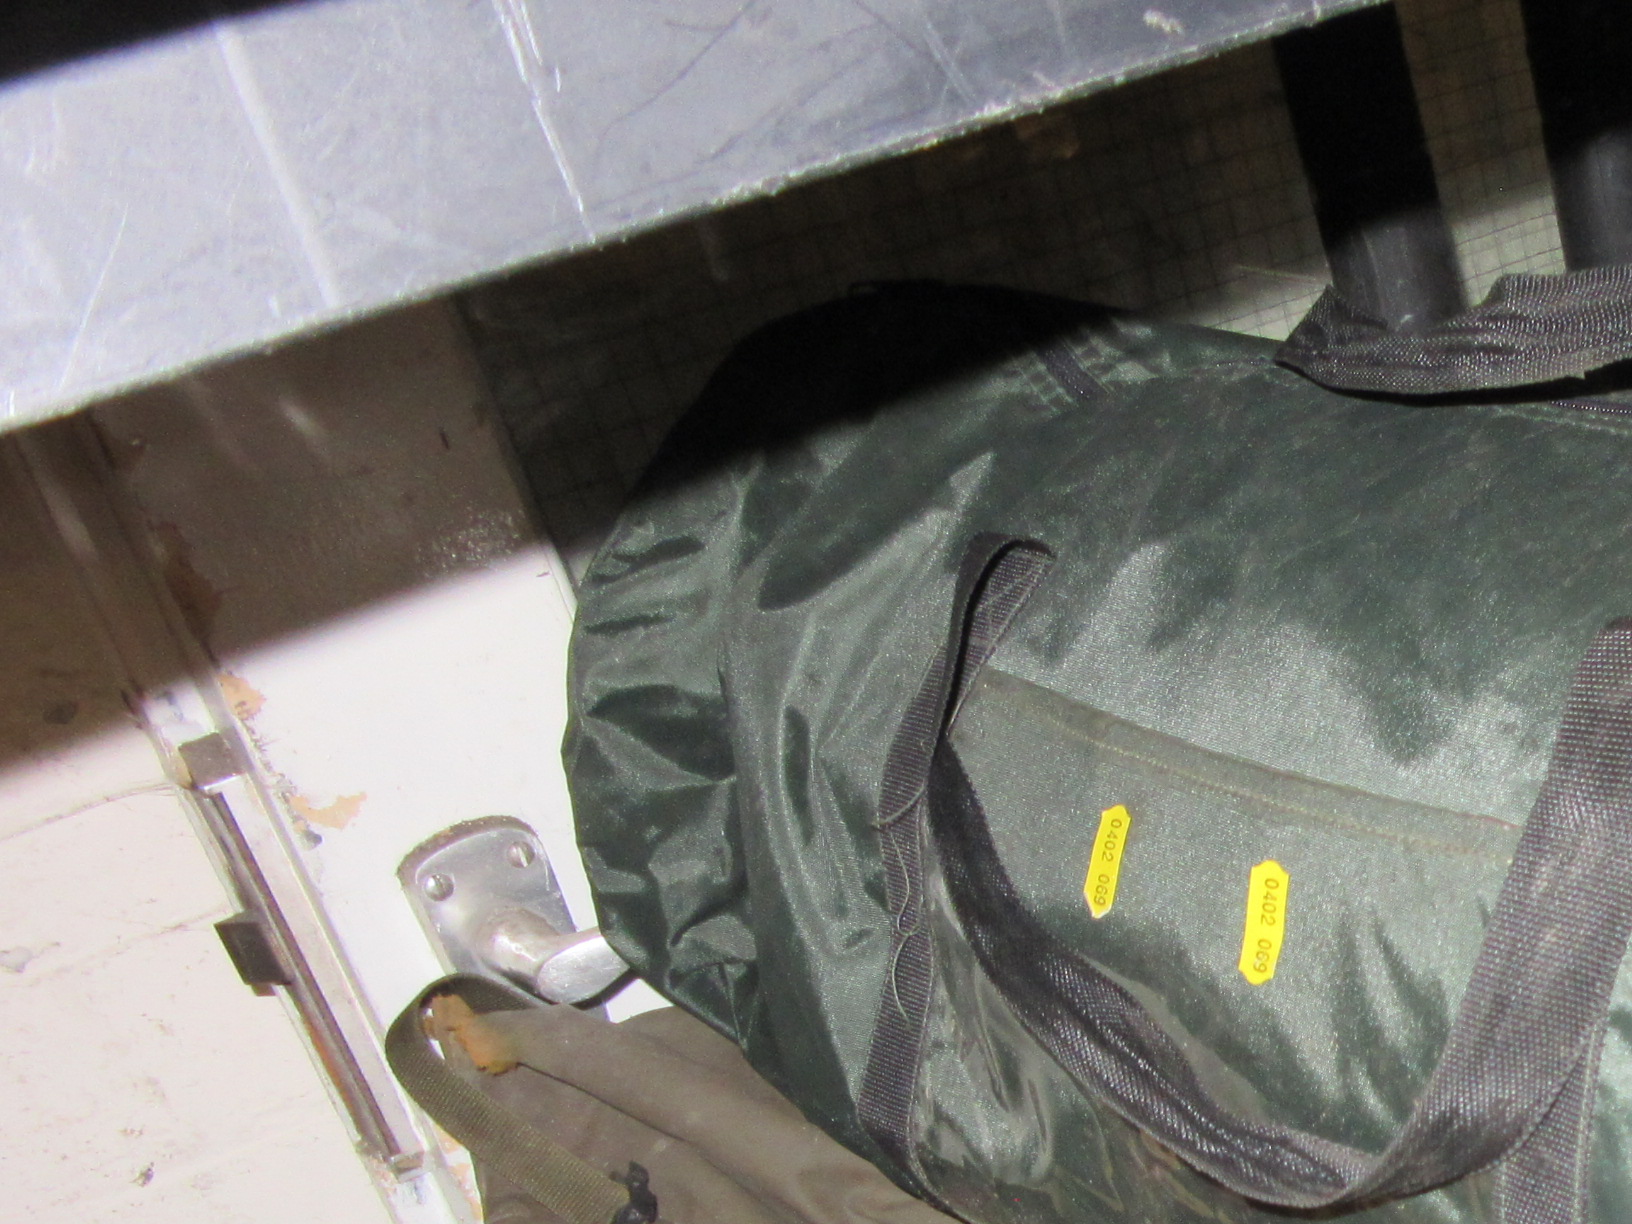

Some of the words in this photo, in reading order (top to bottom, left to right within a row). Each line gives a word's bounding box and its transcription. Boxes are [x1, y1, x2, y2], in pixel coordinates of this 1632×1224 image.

[1101, 817, 1123, 863] 0402
[1092, 873, 1111, 907] 069
[1260, 877, 1279, 927] 0402
[1252, 937, 1272, 974] 069
